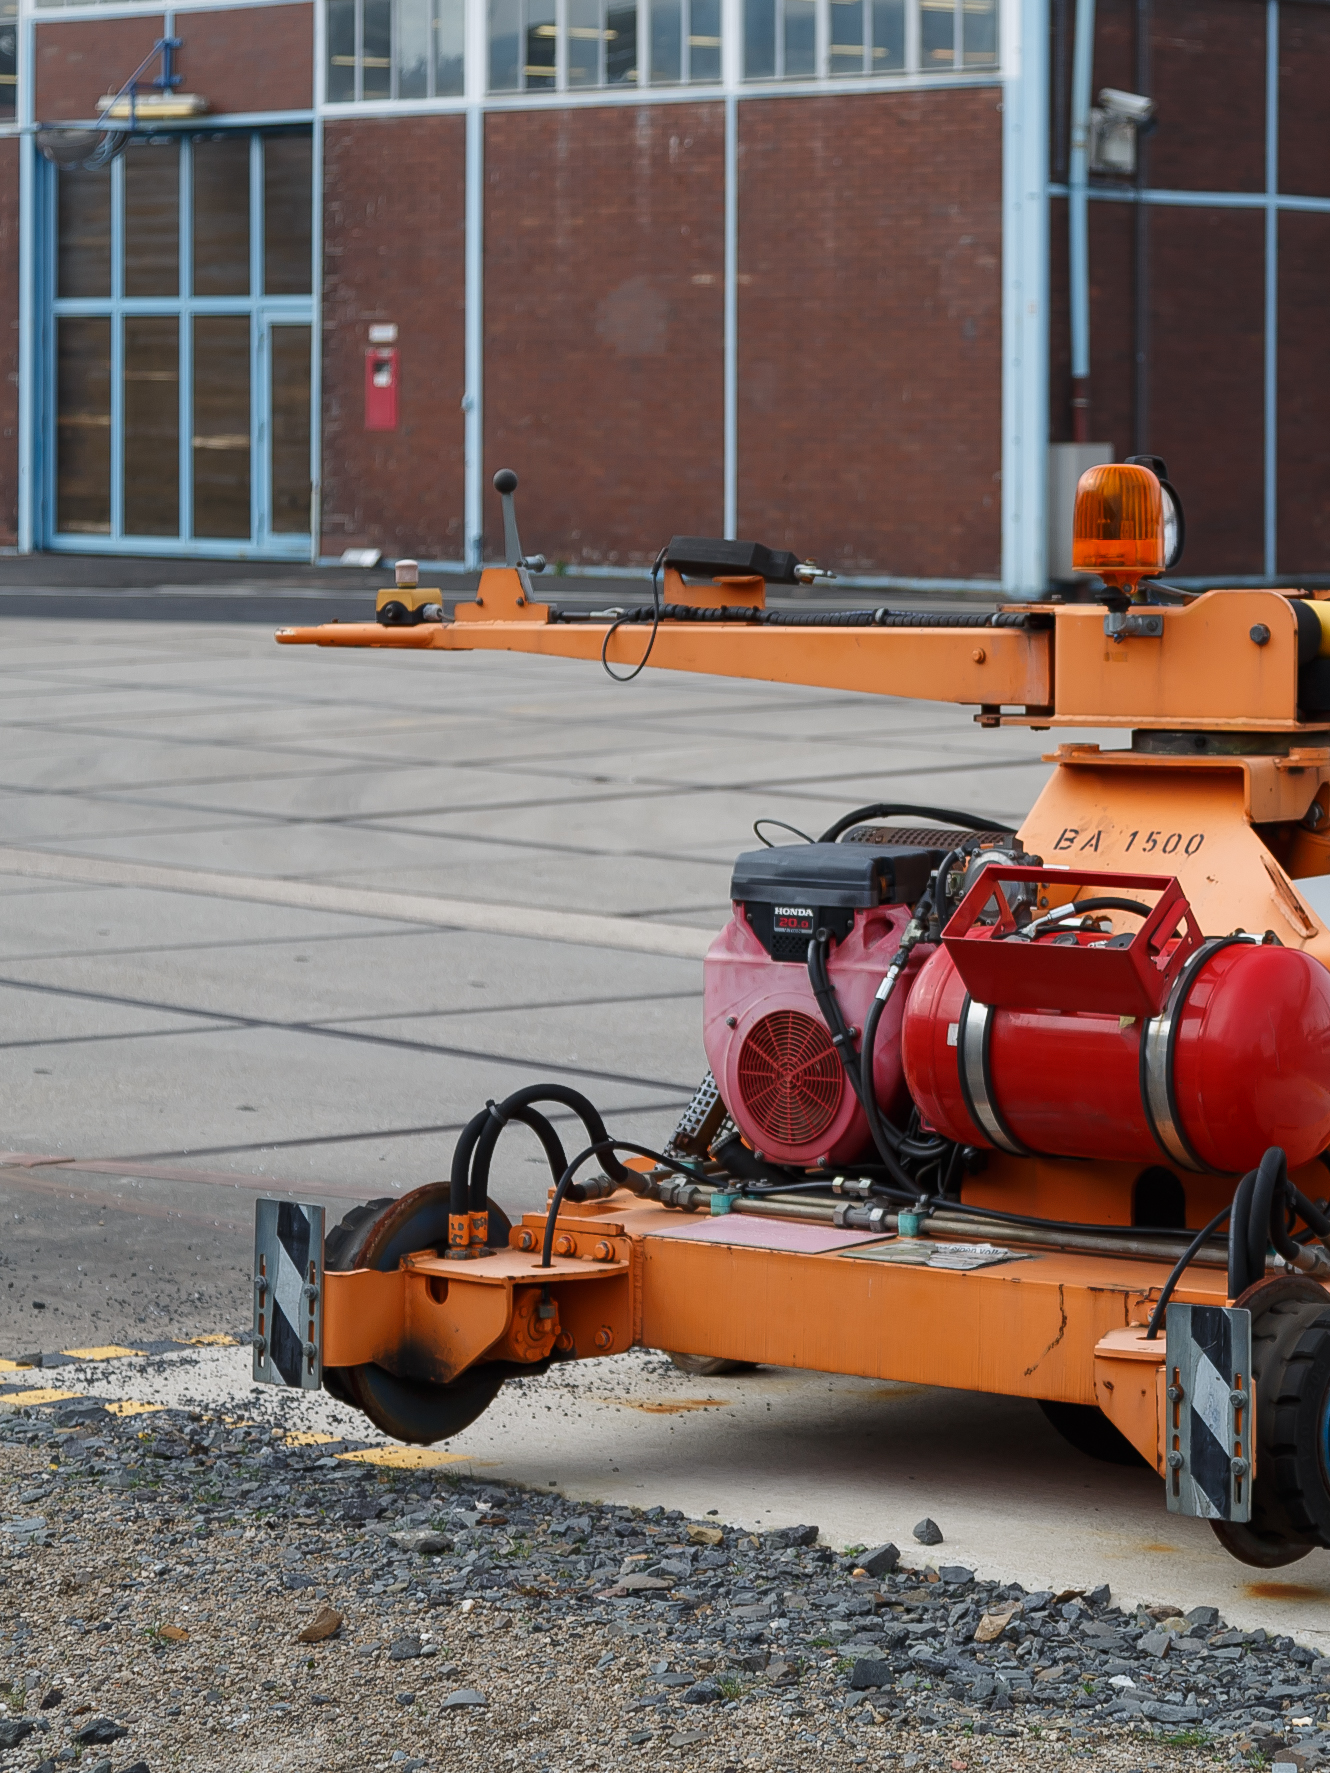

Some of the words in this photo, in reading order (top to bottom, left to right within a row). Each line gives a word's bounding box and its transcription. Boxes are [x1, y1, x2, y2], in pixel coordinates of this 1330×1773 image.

[1053, 828, 1102, 852] BA
[1125, 830, 1205, 855] 1500
[774, 906, 814, 917] HONDA
